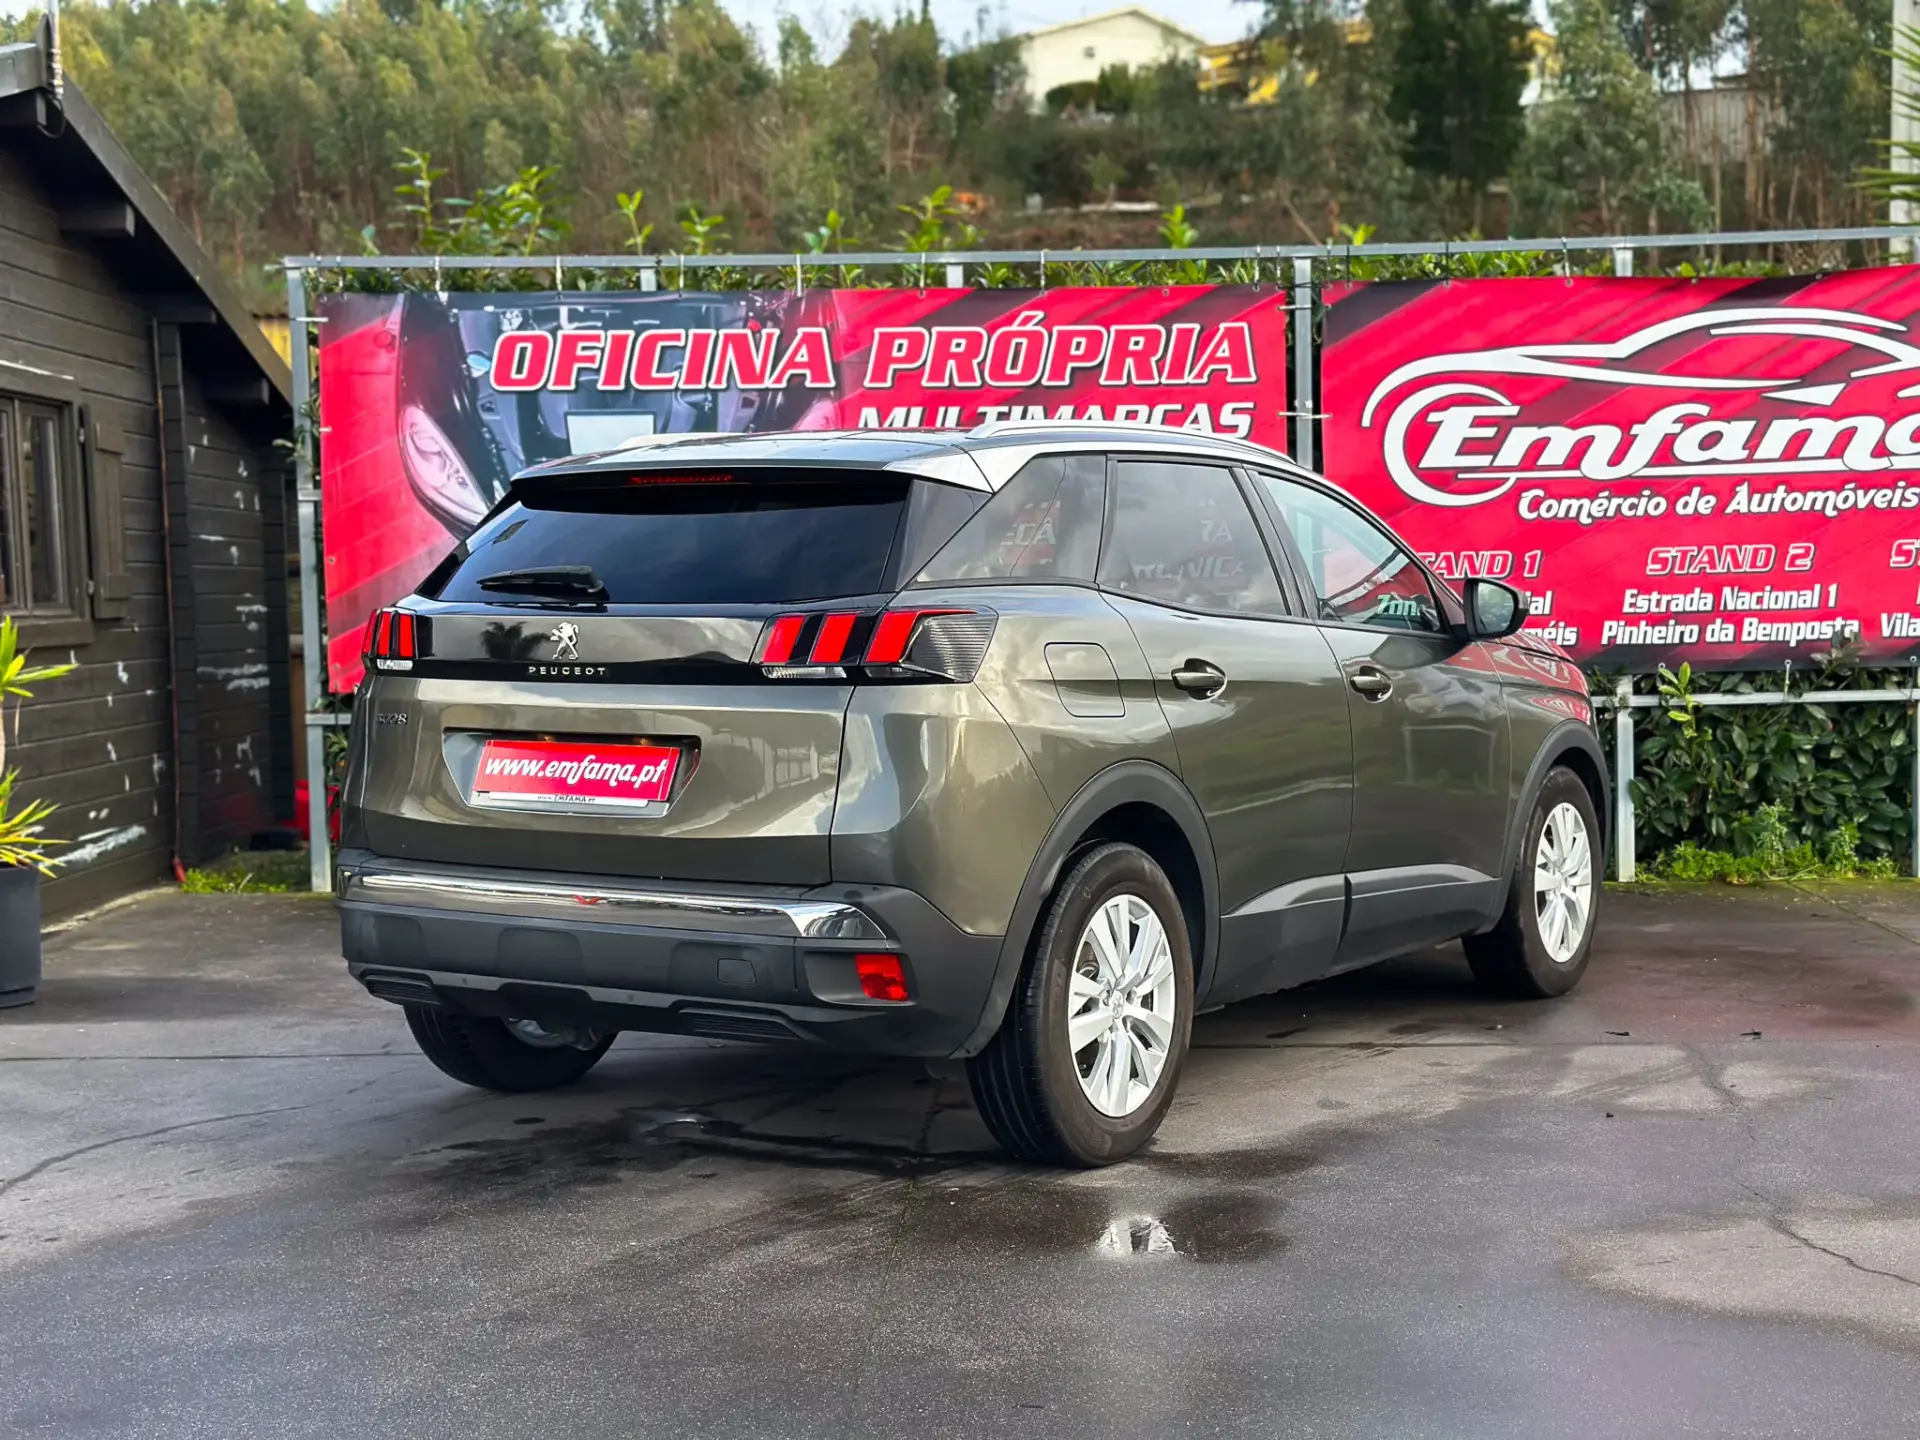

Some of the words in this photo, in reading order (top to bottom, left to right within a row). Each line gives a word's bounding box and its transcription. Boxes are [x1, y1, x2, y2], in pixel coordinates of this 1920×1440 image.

[489, 327, 835, 391] OFICINA
[864, 310, 1257, 388] PRÓPRIA
[1518, 488, 1665, 524] Comércio
[1676, 486, 1716, 516] de
[1725, 481, 1920, 518] Automóveis
[1523, 550, 1544, 577] 1
[1646, 543, 1775, 575] STAND
[1784, 543, 1815, 571] 2
[1622, 587, 1714, 613] Estrada
[1720, 583, 1821, 610] Nacional
[1827, 583, 1838, 608] 1
[1601, 619, 1698, 645] Pinheiro
[1705, 618, 1735, 642] da
[1741, 617, 1860, 647] Bemposta
[528, 666, 606, 676] PEUGEOT
[484, 754, 669, 788] www.emfama.pt
